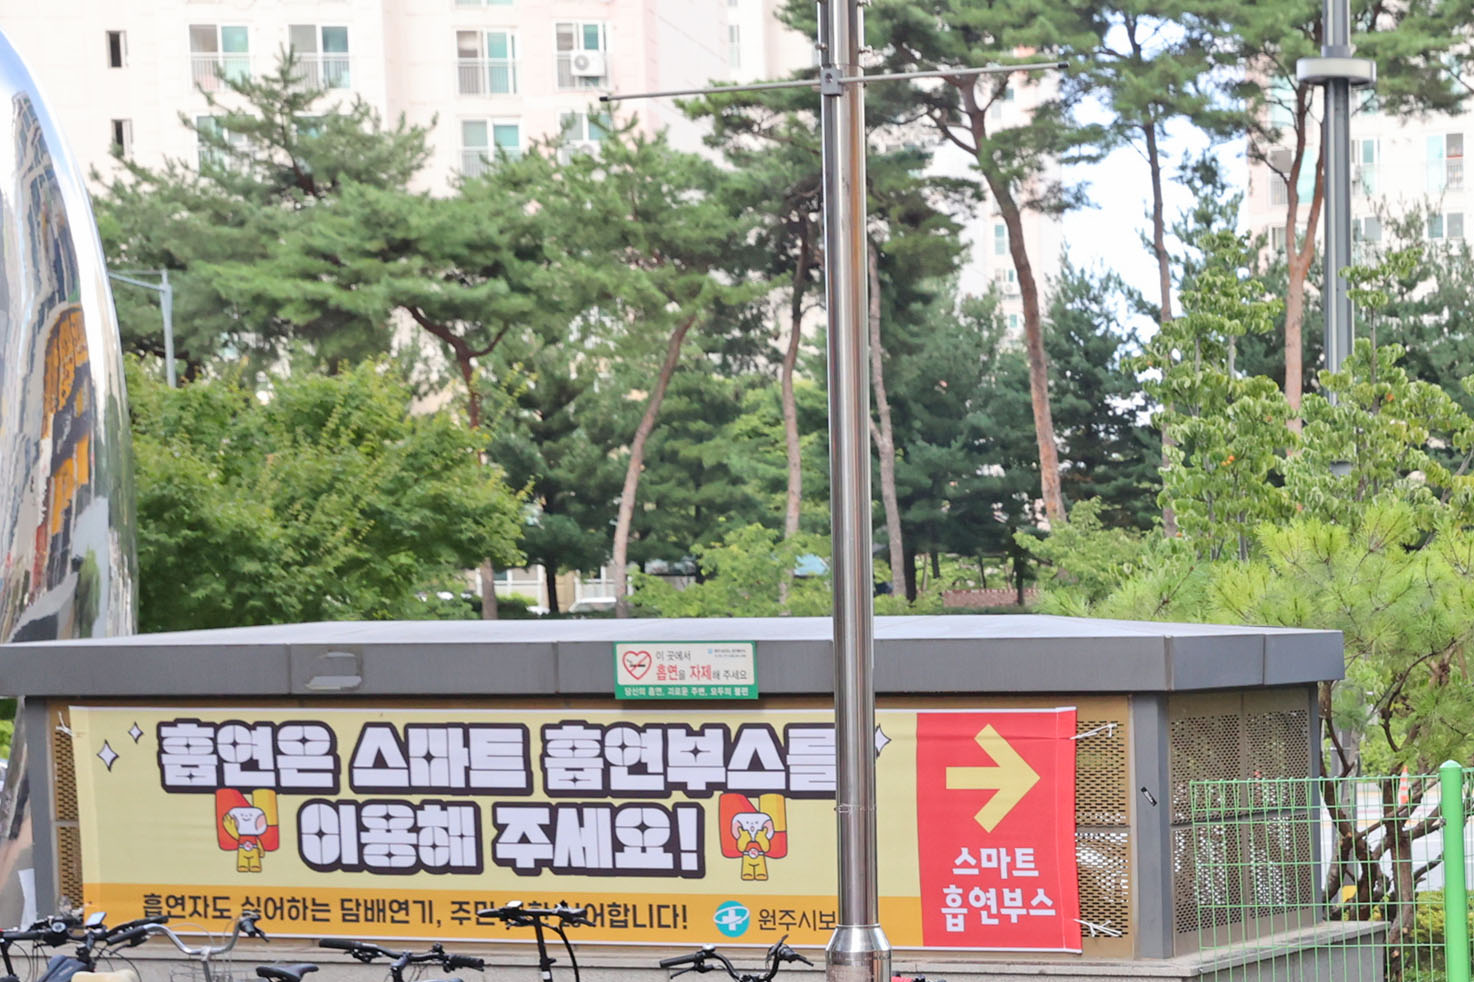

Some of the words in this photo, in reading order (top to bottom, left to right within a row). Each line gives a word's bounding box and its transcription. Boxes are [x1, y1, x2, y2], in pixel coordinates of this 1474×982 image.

[656, 650, 665, 661] 이
[667, 650, 691, 661] 곳에서
[656, 664, 686, 681] 흡연을
[723, 669, 748, 681] 주세요
[157, 718, 341, 795] 흡연은
[349, 721, 533, 797] 스마트
[540, 719, 837, 800] 흡연부스를
[297, 799, 484, 874] 이용해
[492, 802, 706, 879] 주세요!
[952, 846, 1040, 880] 스마트
[143, 893, 233, 920] 흡연자도
[340, 897, 442, 928] 담배연기,
[556, 902, 688, 931] 어합니다!
[941, 884, 1056, 933] 흡연부스
